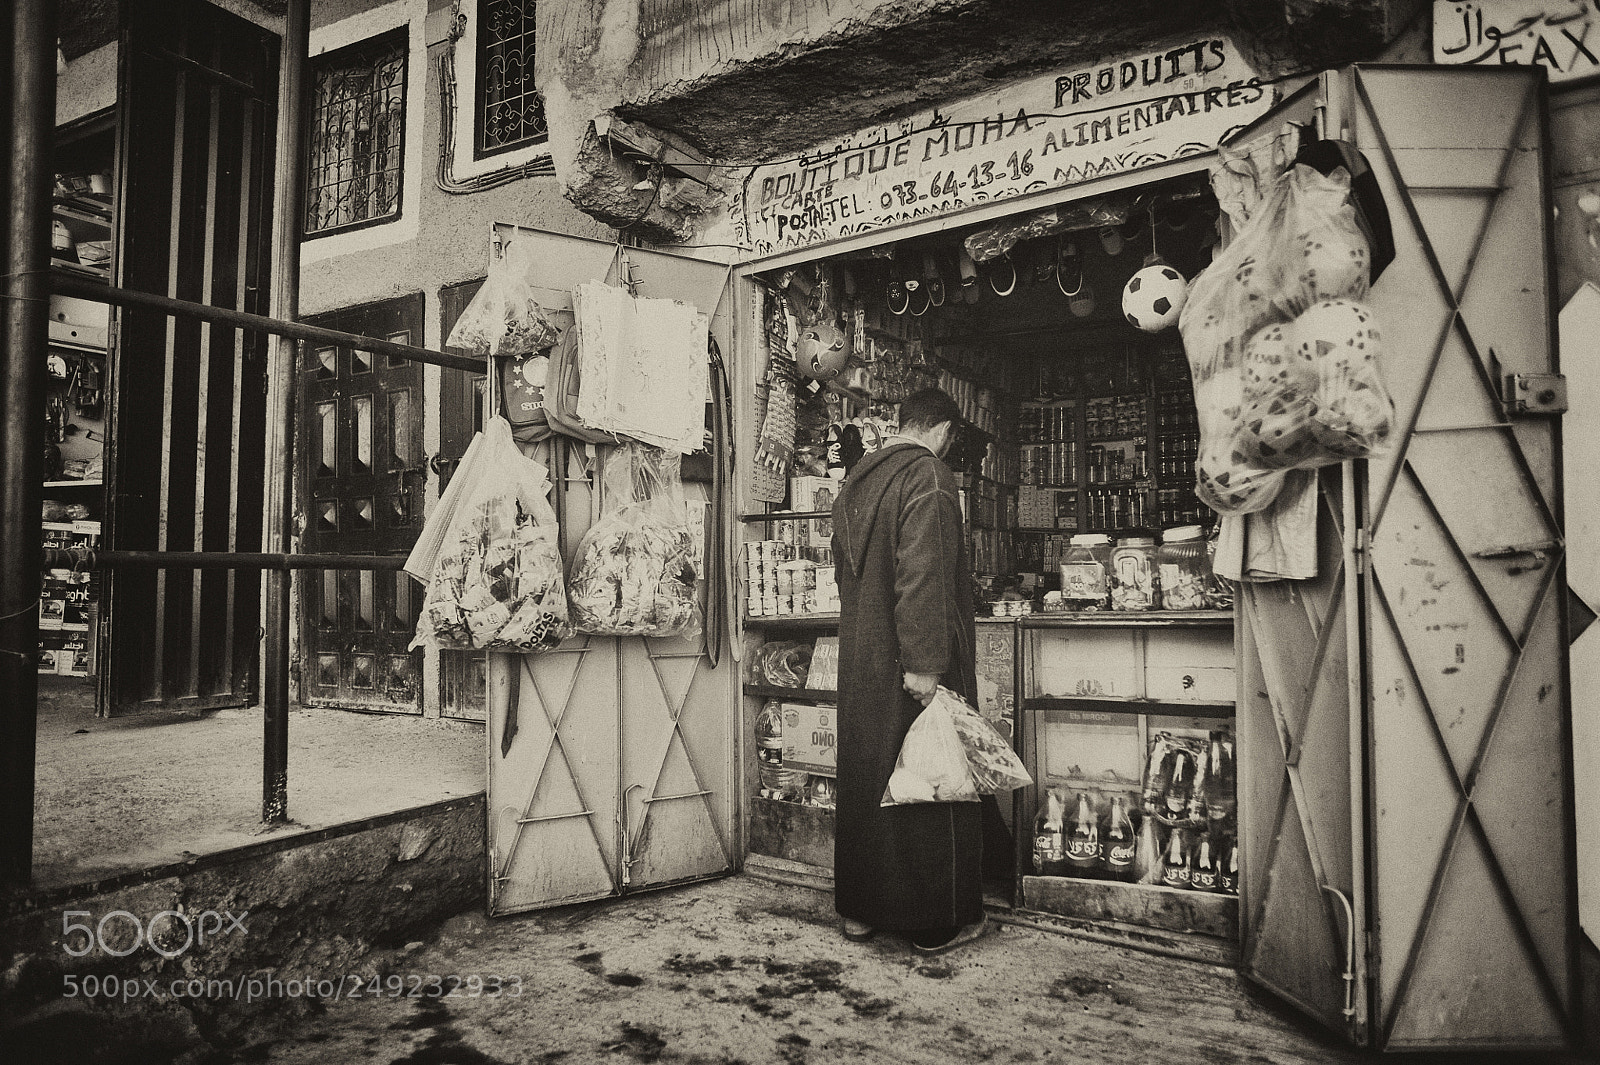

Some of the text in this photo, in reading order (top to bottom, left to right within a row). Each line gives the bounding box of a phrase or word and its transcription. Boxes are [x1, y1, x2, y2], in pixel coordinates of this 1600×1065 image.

[1054, 40, 1226, 109] PRODUITS
[1042, 77, 1264, 156] ALIMENTAIRES
[761, 108, 1034, 206] BOUTIQUE MOHA
